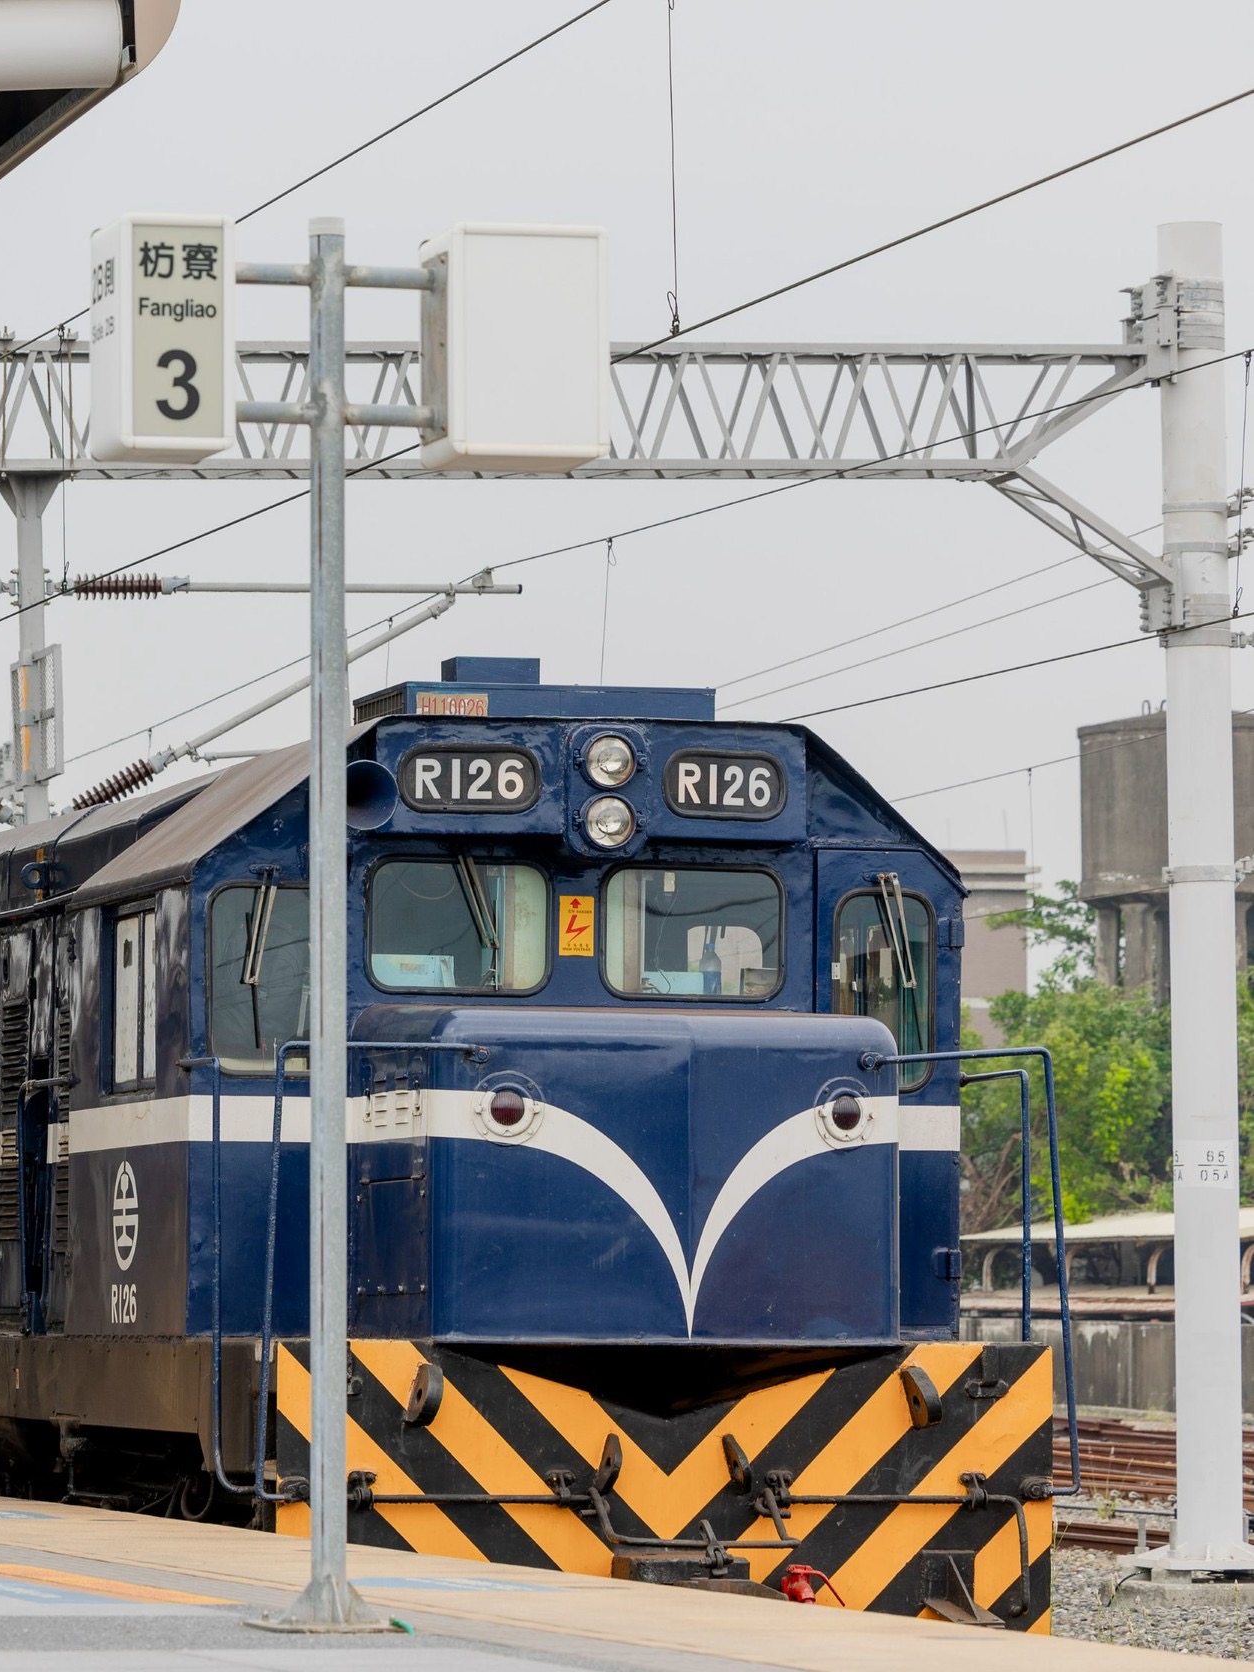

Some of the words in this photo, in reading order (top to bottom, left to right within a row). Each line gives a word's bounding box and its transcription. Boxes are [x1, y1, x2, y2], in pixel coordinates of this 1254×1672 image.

[138, 241, 218, 281] 枋寮
[138, 297, 217, 322] Fangliao
[156, 349, 200, 420] 3
[414, 758, 525, 801] R126
[677, 762, 772, 808] R126
[111, 1284, 137, 1324] R126
